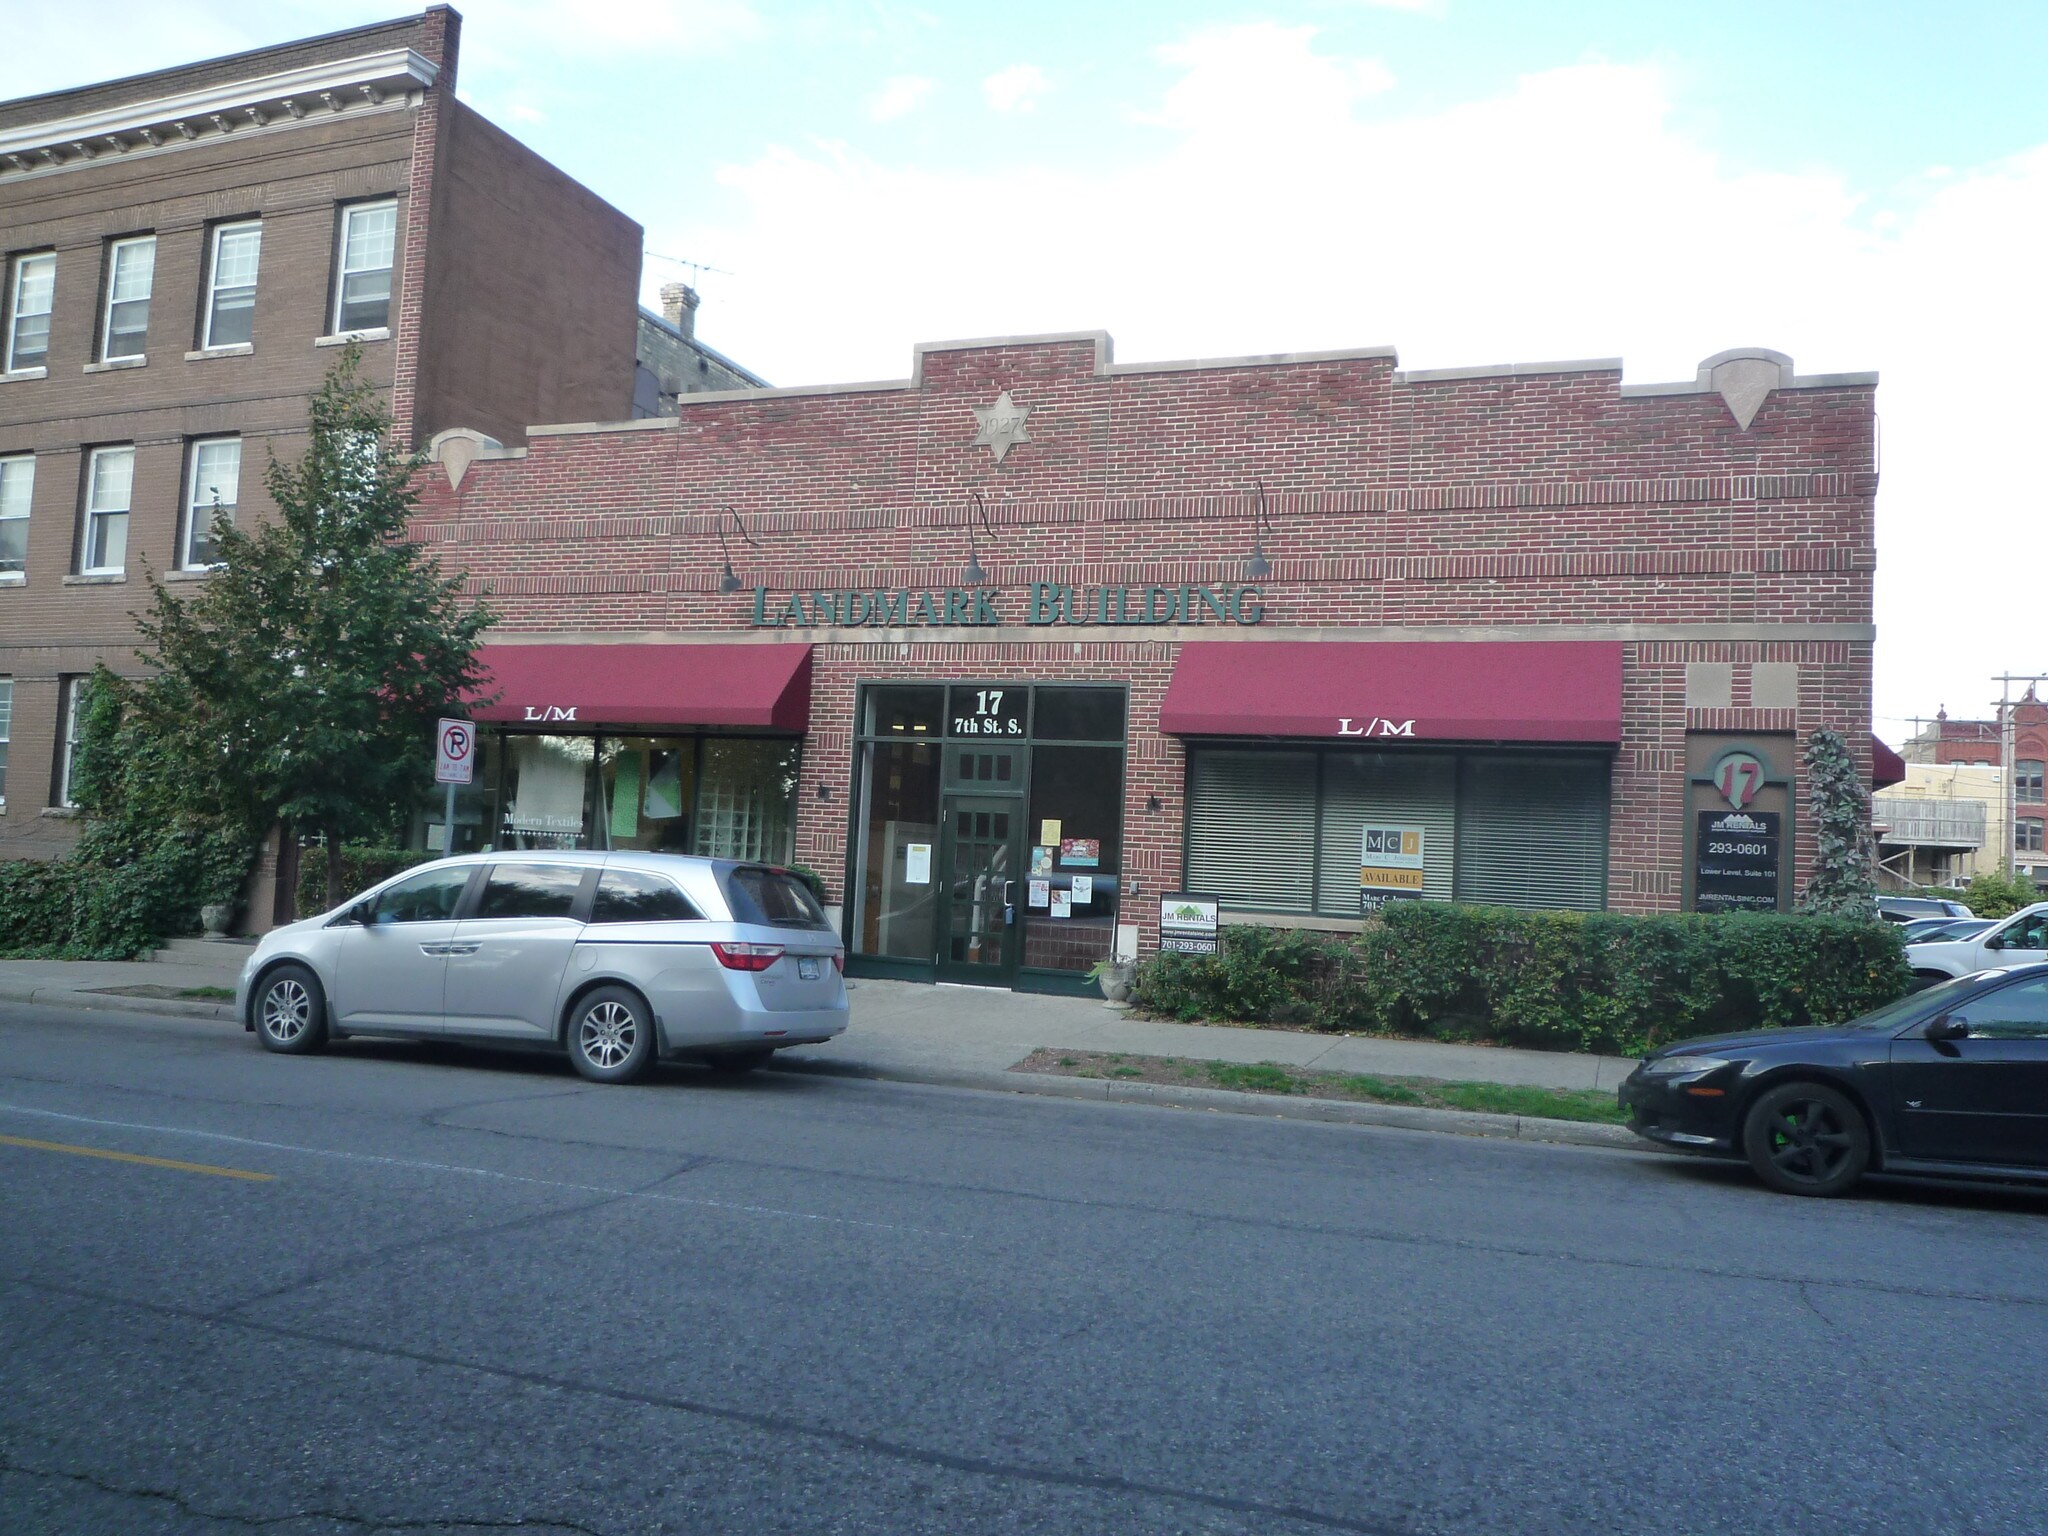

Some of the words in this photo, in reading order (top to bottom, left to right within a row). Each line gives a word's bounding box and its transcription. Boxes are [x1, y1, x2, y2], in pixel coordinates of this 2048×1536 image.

[751, 586, 1000, 627] LANDMARK
[1027, 581, 1264, 625] BUILDING
[976, 690, 1003, 715] 17
[524, 706, 578, 721] L/M
[954, 718, 979, 733] 7th
[983, 718, 1003, 734] St.
[1007, 718, 1022, 734] S.
[1337, 717, 1416, 736] L/M
[1720, 762, 1760, 804] 17
[504, 813, 542, 825] Modern
[545, 814, 584, 828] Textiles
[1726, 821, 1767, 830] RENTALS
[1709, 842, 1768, 855] 293-0601
[1364, 872, 1419, 885] AVAILABLE
[1744, 869, 1762, 877] Suite
[1764, 870, 1776, 878] 101
[1163, 912, 1175, 920] JM
[1177, 913, 1216, 923] RENTALS
[1162, 941, 1216, 951] 701-293-0601
